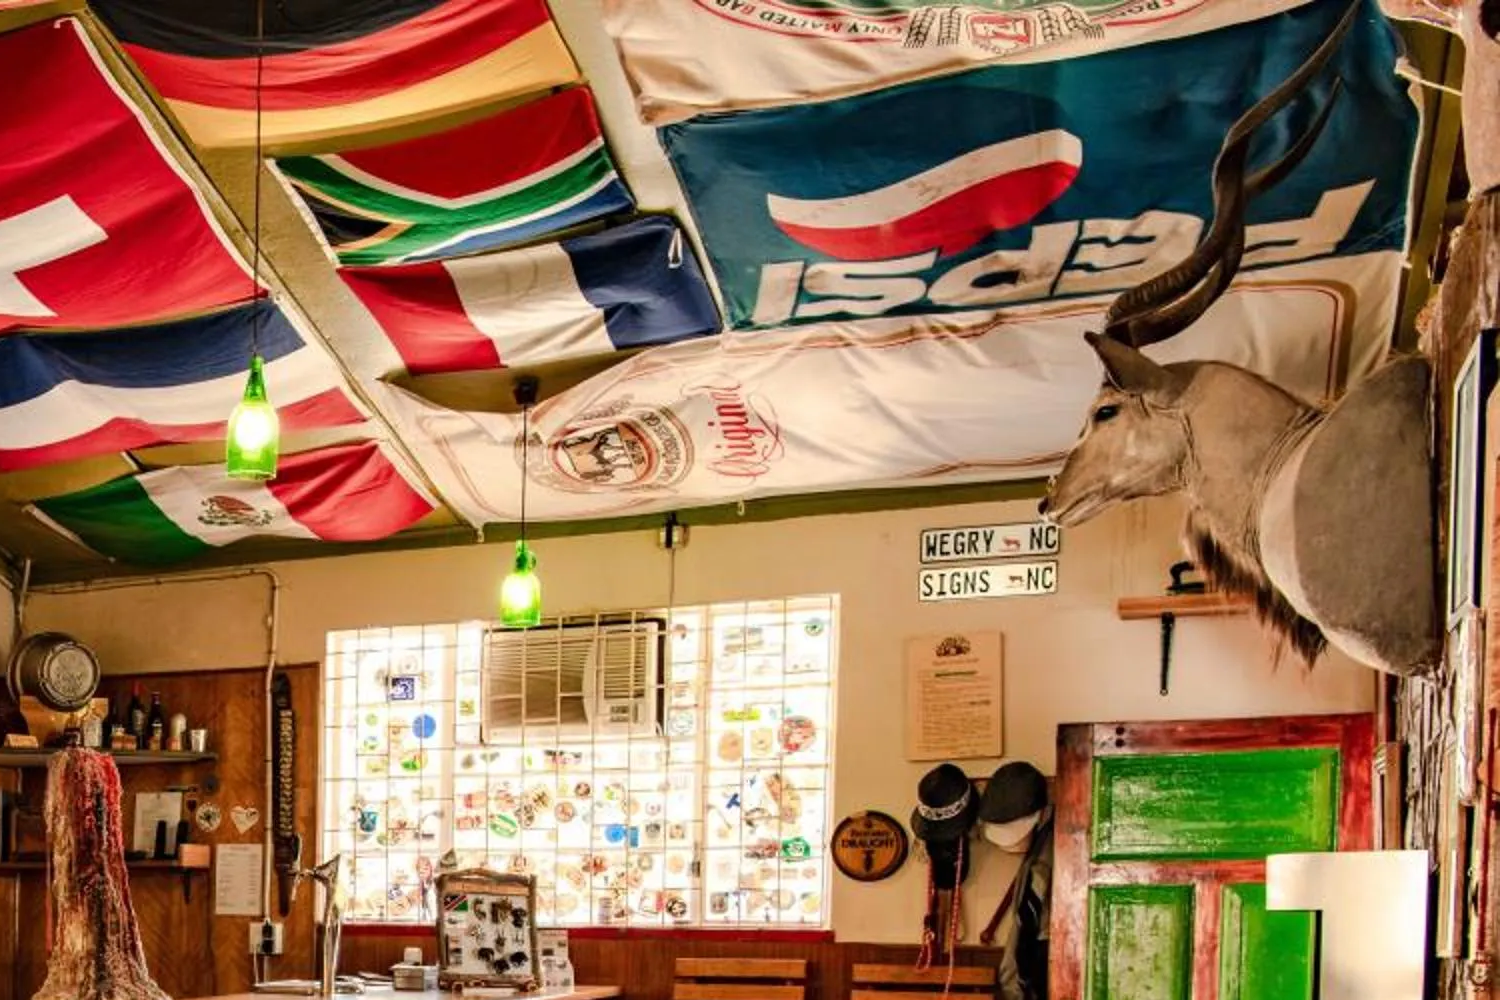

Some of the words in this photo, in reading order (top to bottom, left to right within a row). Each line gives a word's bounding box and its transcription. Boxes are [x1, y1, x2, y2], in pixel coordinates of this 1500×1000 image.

[760, 10, 843, 34] MALTED
[750, 178, 1379, 327] PEPSI
[688, 374, 784, 478] Original
[925, 529, 995, 558] WEGRY
[1029, 525, 1057, 551] NC
[922, 569, 991, 597] SIGNS
[1026, 566, 1054, 591] NC
